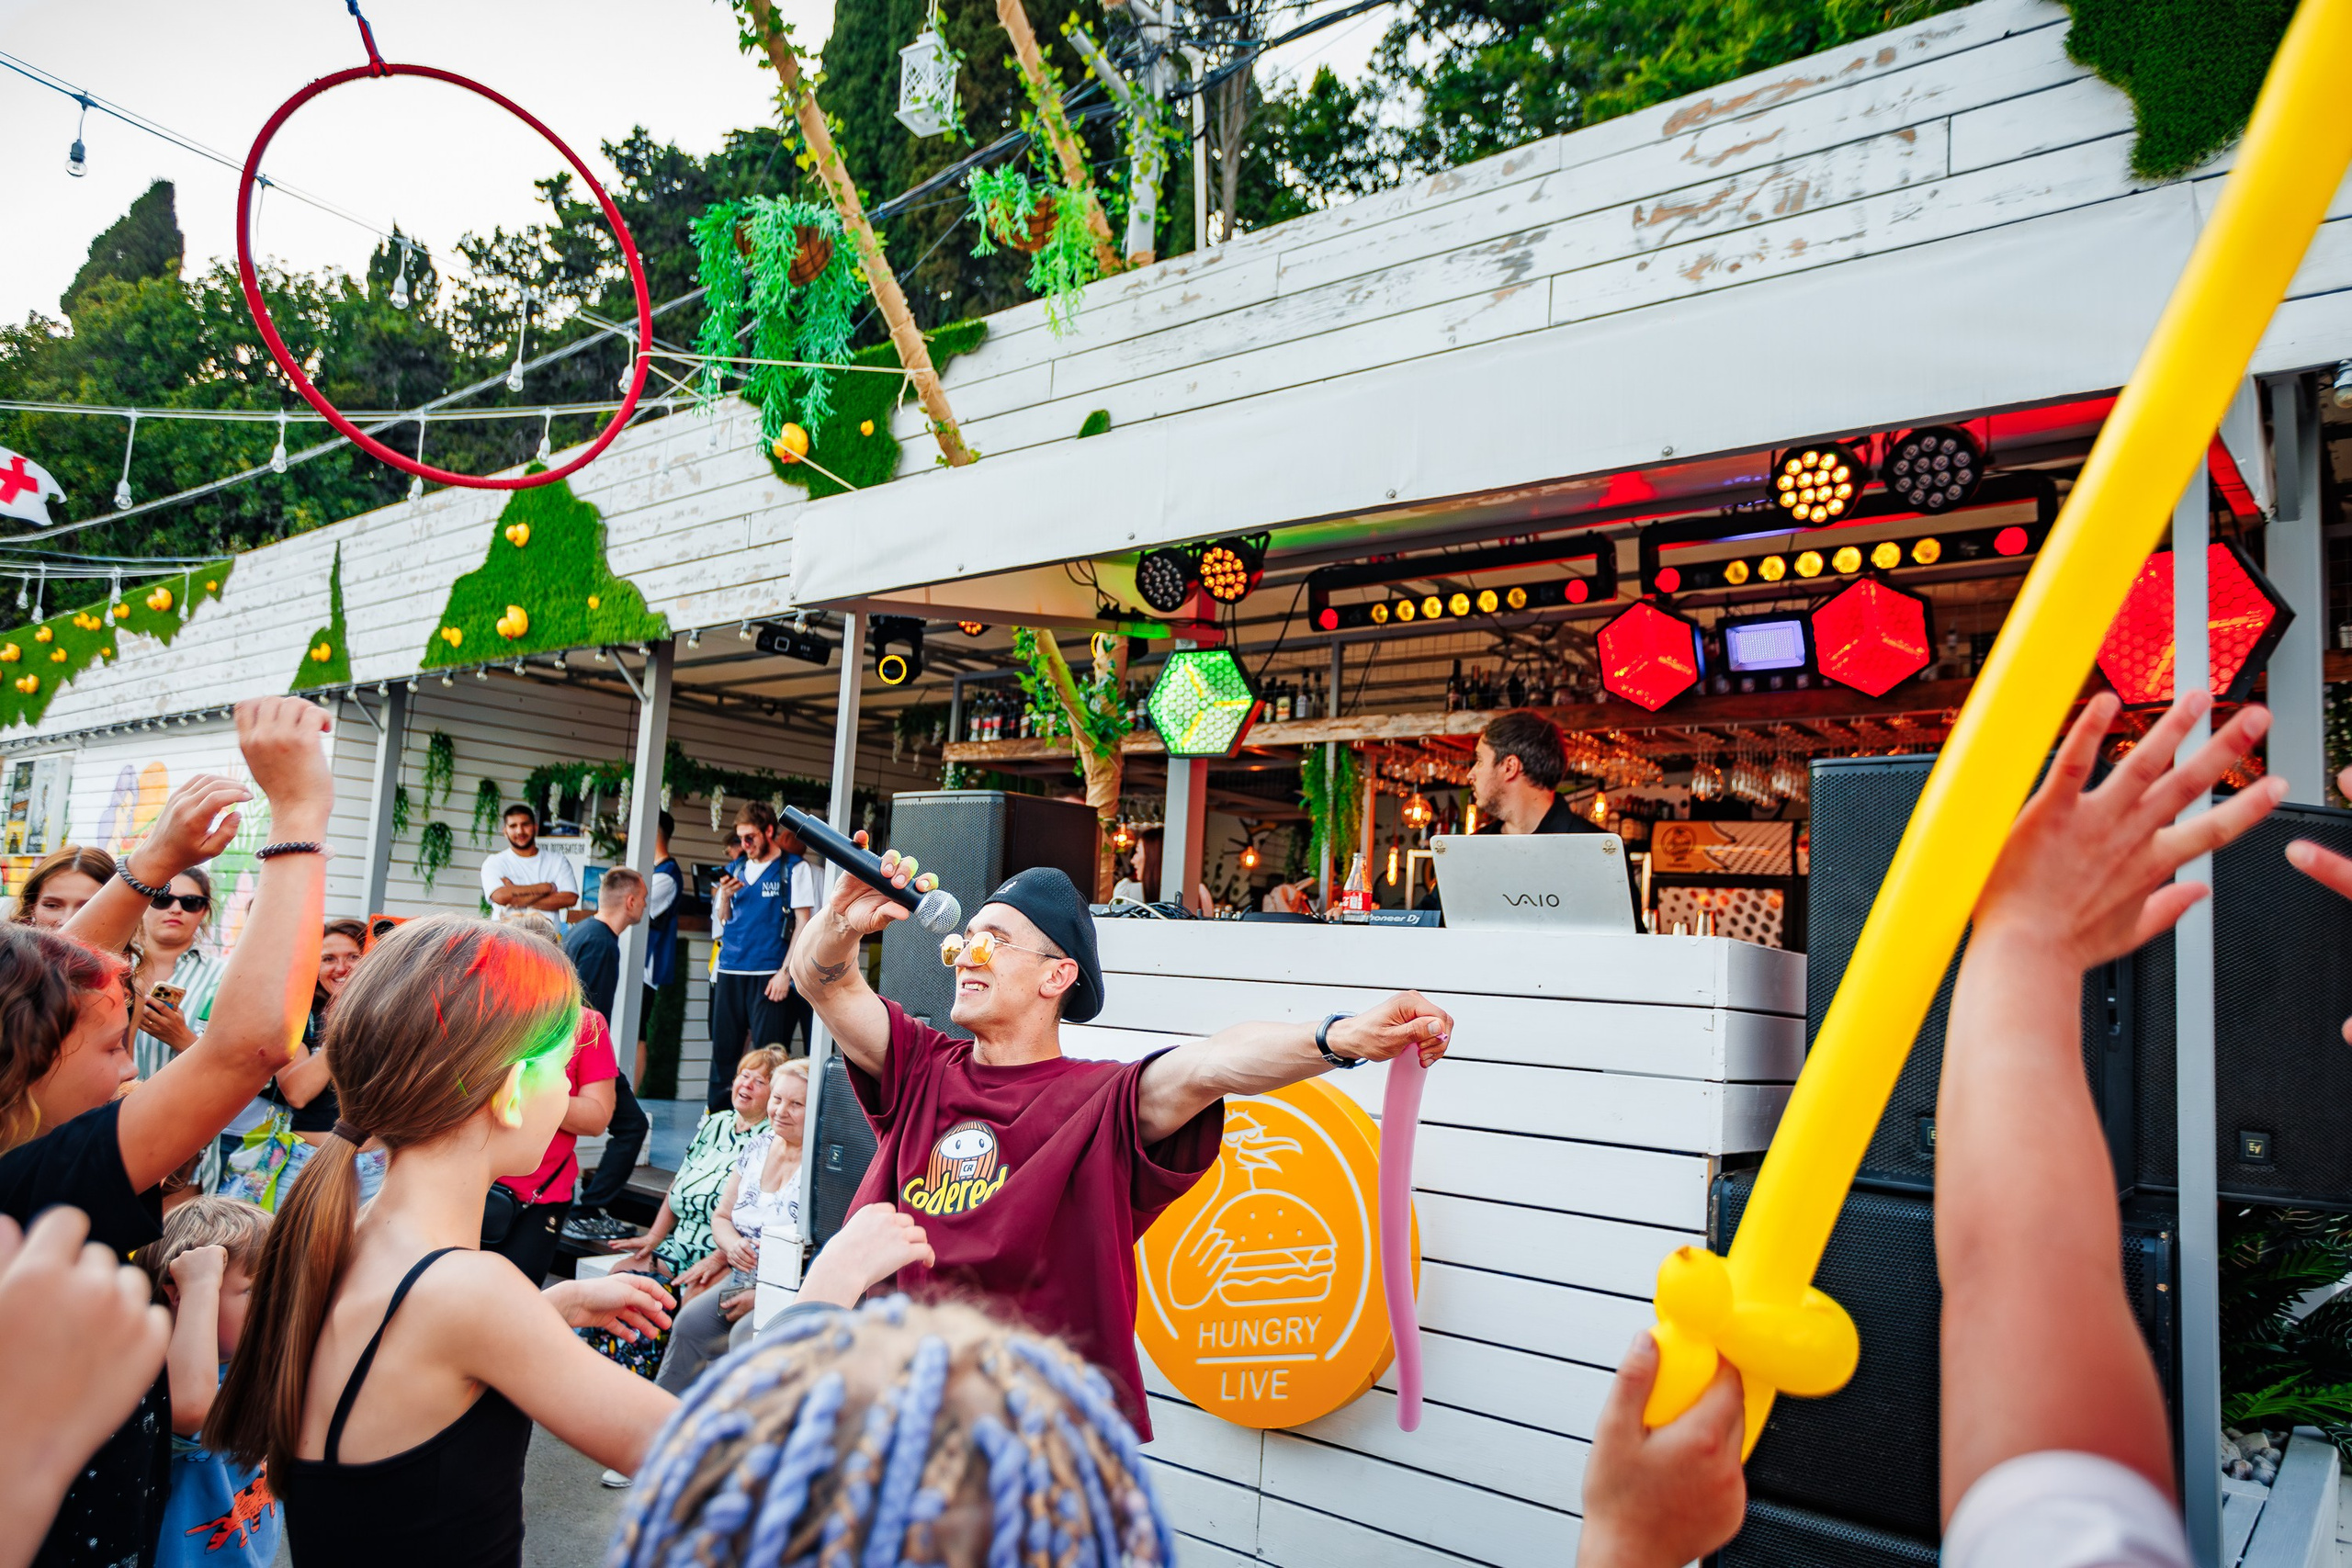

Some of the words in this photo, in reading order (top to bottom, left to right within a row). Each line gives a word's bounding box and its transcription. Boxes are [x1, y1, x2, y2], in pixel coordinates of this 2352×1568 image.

[1502, 894, 1560, 908] VAIO
[1370, 914, 1406, 922] ioneer
[902, 1164, 1009, 1216] Codered
[1198, 1314, 1322, 1348] HUNGRY
[1220, 1369, 1289, 1401] LIVE
